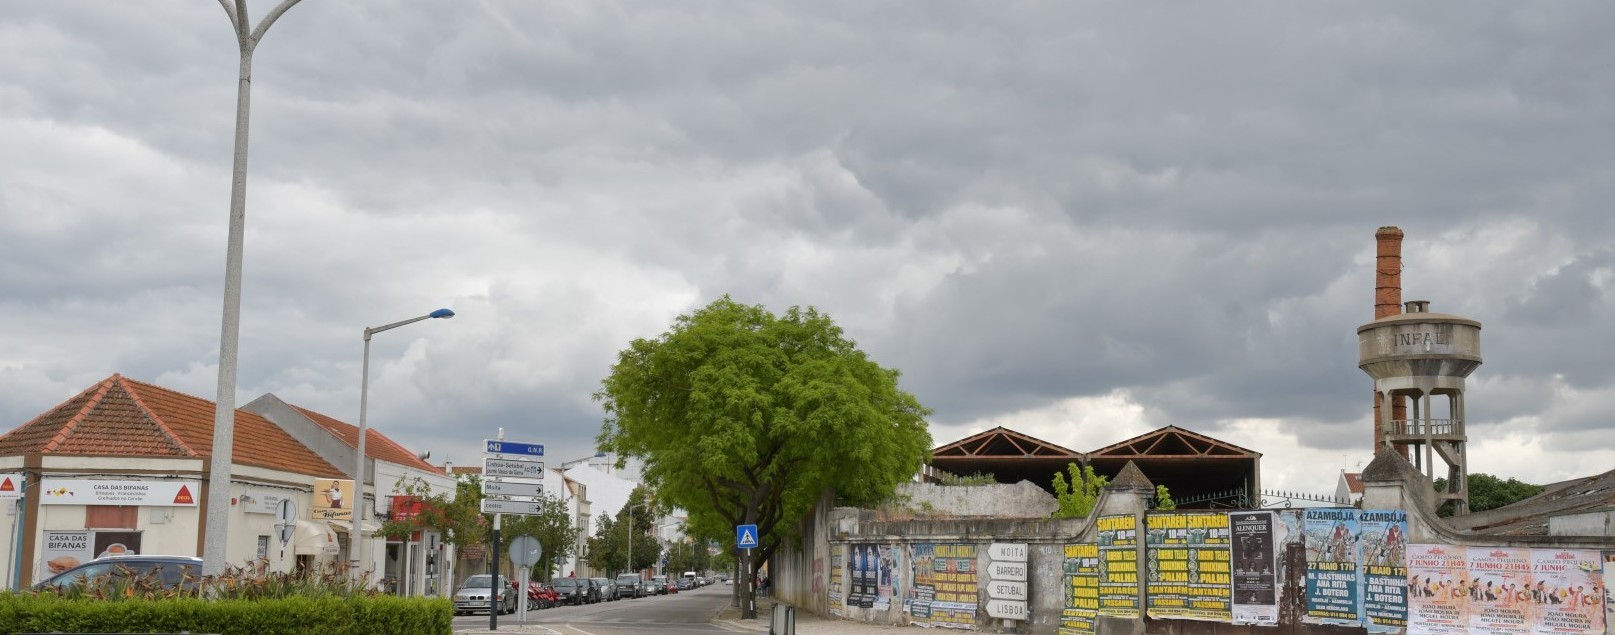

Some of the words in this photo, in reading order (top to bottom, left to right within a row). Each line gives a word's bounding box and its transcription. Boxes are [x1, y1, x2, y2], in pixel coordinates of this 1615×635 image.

[322, 510, 352, 518] Bifanas
[1097, 515, 1136, 530] SANTARÉM
[1147, 514, 1186, 529] SANTARÉM
[1188, 513, 1228, 528] SANTARÉM
[1236, 524, 1267, 533] ALENQUER
[1118, 531, 1126, 540] 10
[1168, 529, 1176, 538] 10
[1209, 529, 1218, 538] 10
[1001, 548, 1023, 557] MOITA
[1319, 562, 1338, 570] MAIO
[1362, 565, 1368, 573] 7
[1370, 566, 1391, 575] MAIO
[1394, 568, 1407, 576] 17H
[996, 566, 1023, 576] BARREIRO
[1108, 573, 1137, 582] PALHA
[1160, 572, 1188, 581] PALHA
[1200, 574, 1229, 583] PALHA
[1319, 572, 1355, 582] BASTINHAS
[997, 586, 1023, 595] SETUBAL
[1100, 586, 1138, 595] SANTARÉM
[1188, 588, 1230, 596] SANTARÉM
[1323, 589, 1348, 597] BOTERO
[1368, 585, 1383, 593] ANA
[1385, 586, 1401, 594] RITA
[1074, 598, 1099, 608] PALHA
[1374, 595, 1402, 604] BOTERO
[997, 605, 1023, 615] LISBOA
